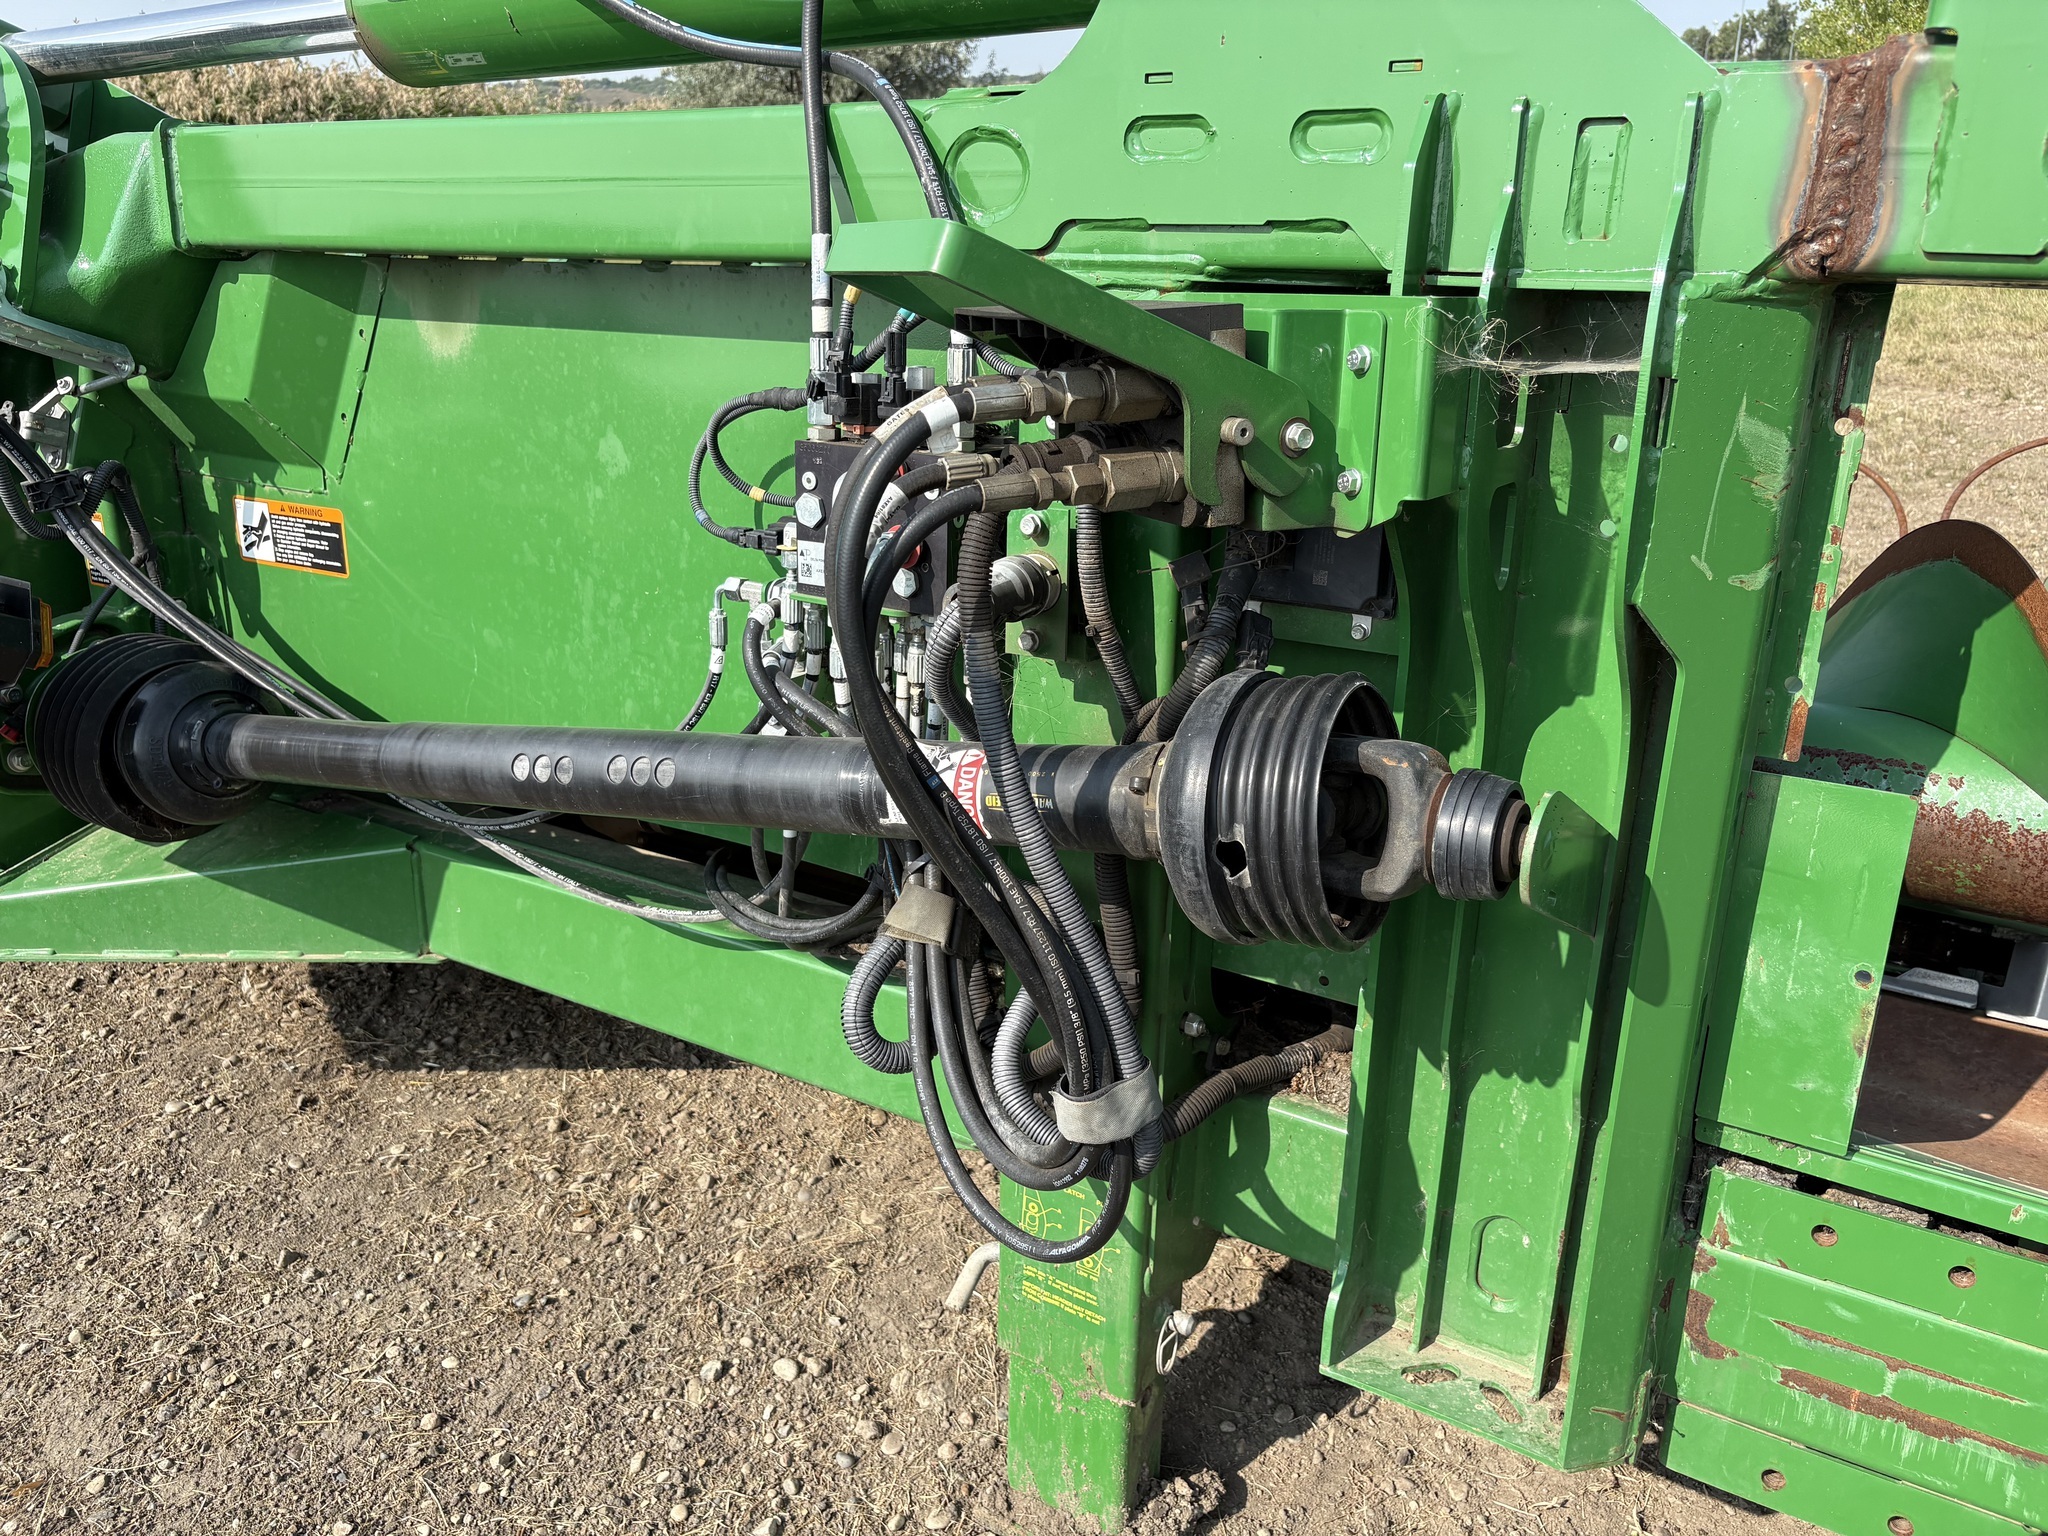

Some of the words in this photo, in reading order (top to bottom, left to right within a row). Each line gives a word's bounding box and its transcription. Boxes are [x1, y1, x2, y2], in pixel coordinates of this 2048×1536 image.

[288, 504, 324, 518] WARNING
[709, 673, 719, 689] R17
[888, 717, 915, 754] Resistant
[912, 752, 932, 778] Flame
[939, 789, 948, 799] B
[958, 766, 981, 821] DANG
[985, 794, 1055, 810] WALEID
[944, 796, 959, 816] Type
[957, 814, 980, 840] 18752
[975, 838, 990, 856] ISO
[540, 866, 558, 879] MADE
[557, 873, 566, 882] IN
[564, 876, 581, 888] ITALY
[988, 857, 1014, 889] 100R17
[1009, 887, 1024, 906] SAE
[1022, 910, 1038, 928] R17
[1034, 926, 1053, 954] 11237
[1047, 953, 1060, 970] ISO
[911, 1033, 917, 1047] DN
[912, 1052, 918, 1063] 10
[1079, 1047, 1091, 1074] (3250
[971, 1204, 981, 1217] IN
[982, 1216, 1002, 1238] ITALY
[1049, 1236, 1091, 1256] ALFAGOMMA
